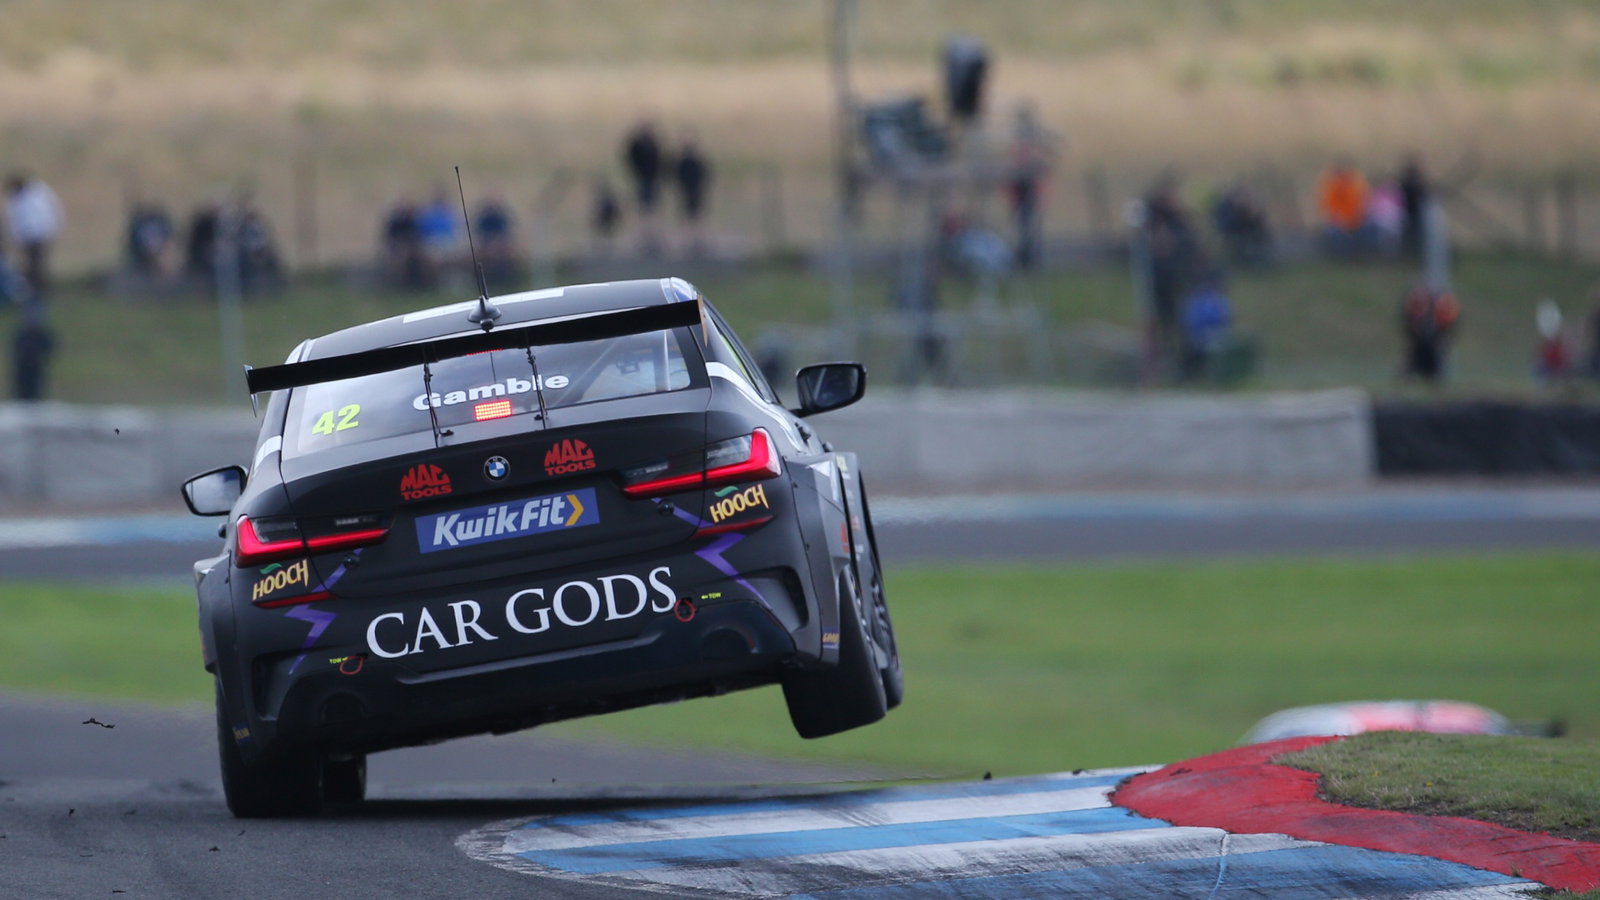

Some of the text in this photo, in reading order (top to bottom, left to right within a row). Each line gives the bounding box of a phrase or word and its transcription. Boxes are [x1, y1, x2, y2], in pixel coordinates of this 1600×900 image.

[412, 375, 569, 411] Gamble
[312, 404, 361, 435] 42
[544, 439, 595, 467] MAC
[544, 459, 596, 476] TOOLS
[400, 464, 451, 492] MAC
[401, 483, 453, 501] TOOLS
[709, 484, 769, 523] HOOCH
[252, 559, 309, 600] HOOCH
[366, 566, 677, 659] CAR GODS
